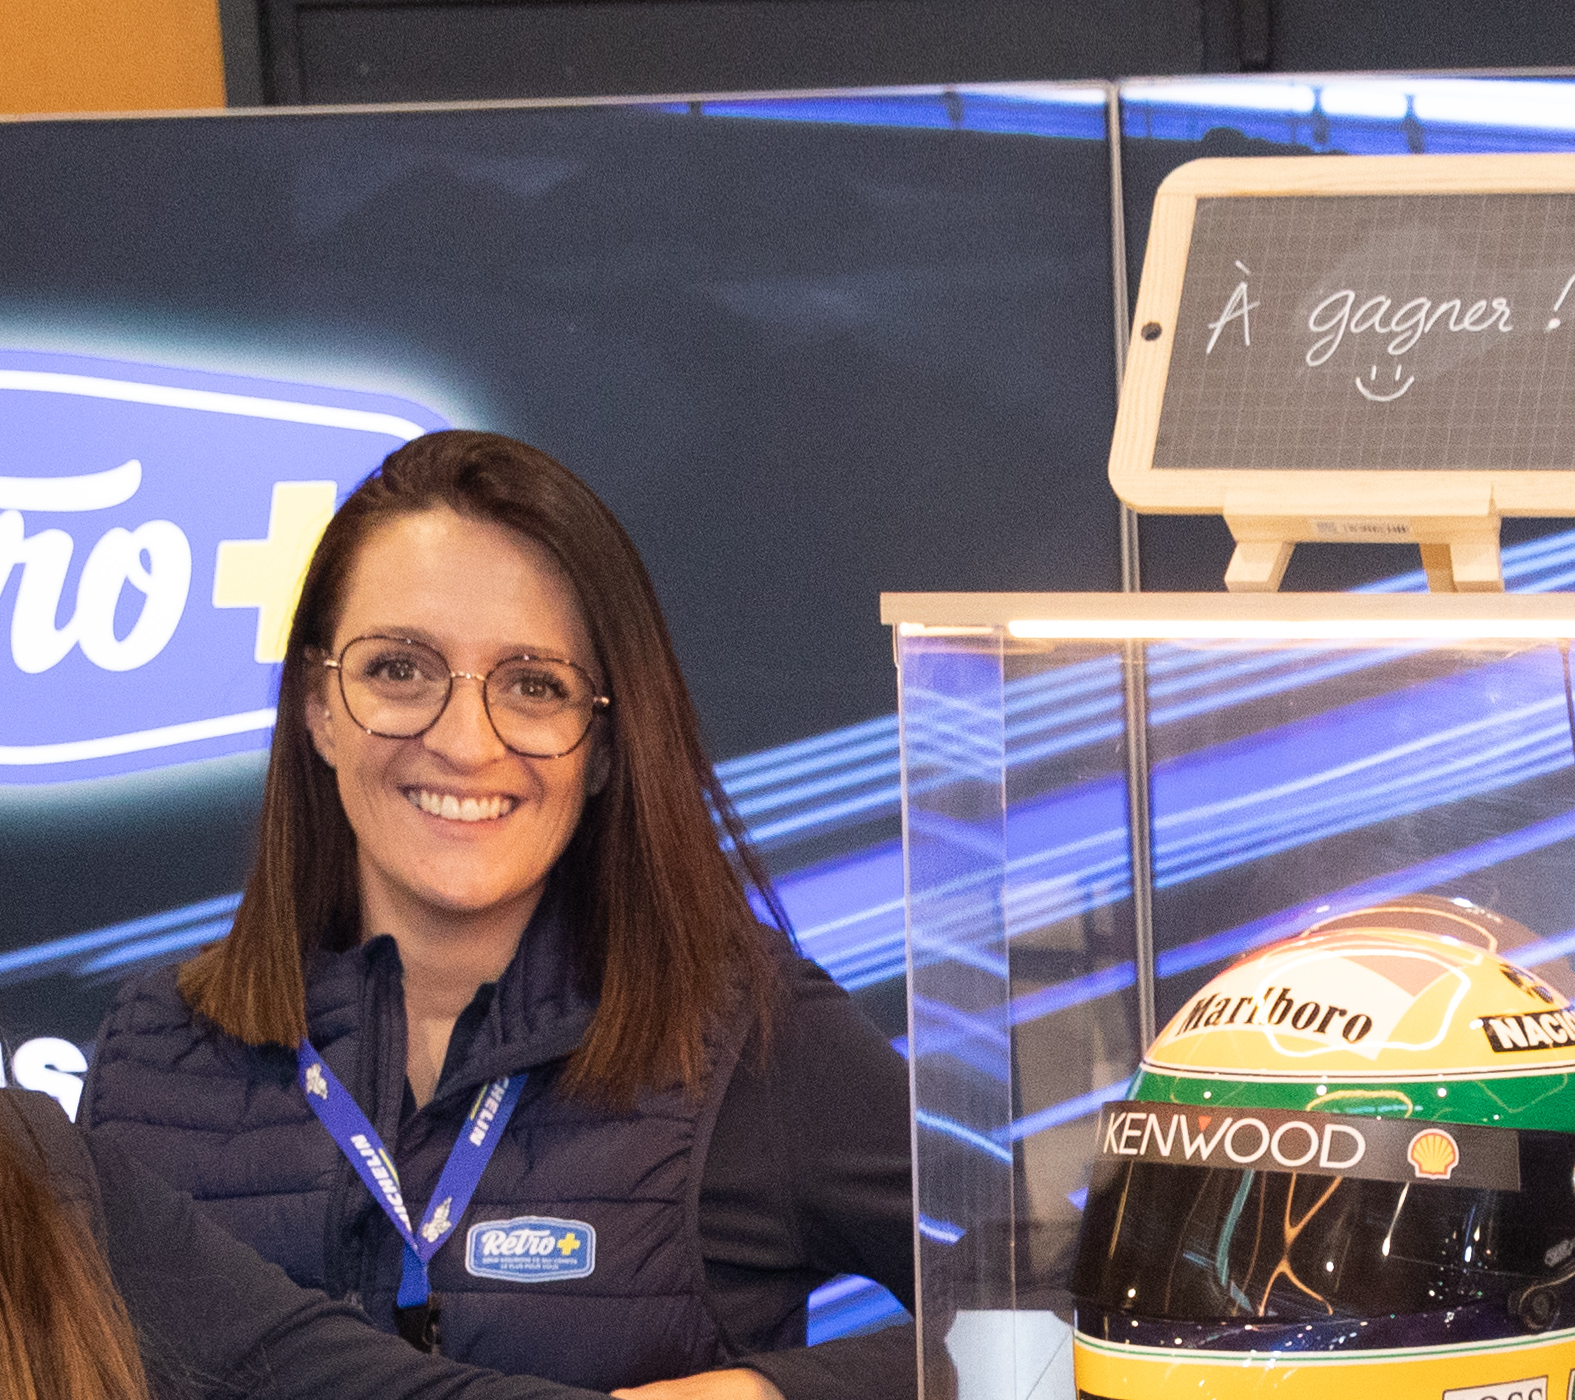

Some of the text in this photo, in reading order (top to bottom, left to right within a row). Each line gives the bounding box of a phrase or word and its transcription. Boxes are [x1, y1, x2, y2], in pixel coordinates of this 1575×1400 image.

[1207, 260, 1260, 354] À
[1306, 290, 1513, 366] gagner
[1175, 987, 1373, 1044] Marlboro
[1103, 1112, 1366, 1169] KENWOOD
